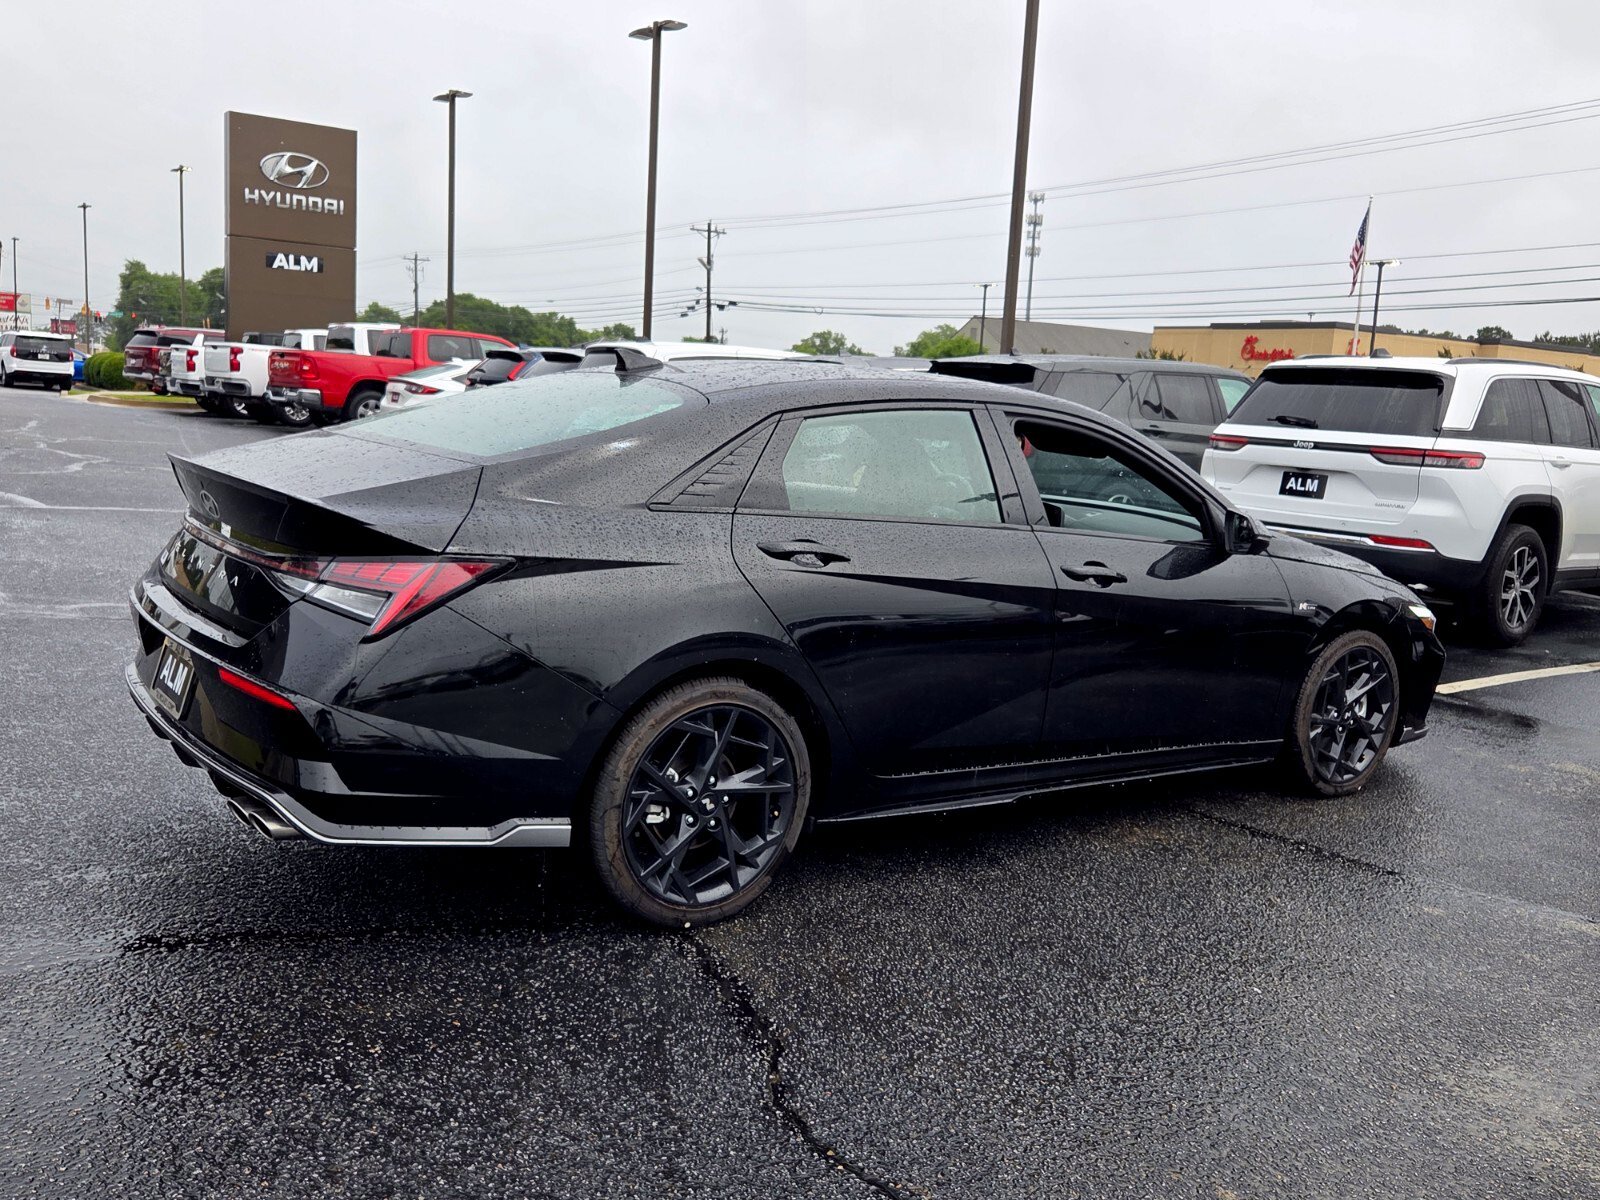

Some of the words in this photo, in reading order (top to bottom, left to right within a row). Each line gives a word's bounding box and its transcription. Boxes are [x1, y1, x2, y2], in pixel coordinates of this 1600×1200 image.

[244, 187, 345, 216] HYUNDAI
[272, 252, 319, 273] ALM
[1293, 440, 1315, 451] Jeep
[1285, 476, 1319, 492] ALM
[160, 654, 188, 696] ALM
